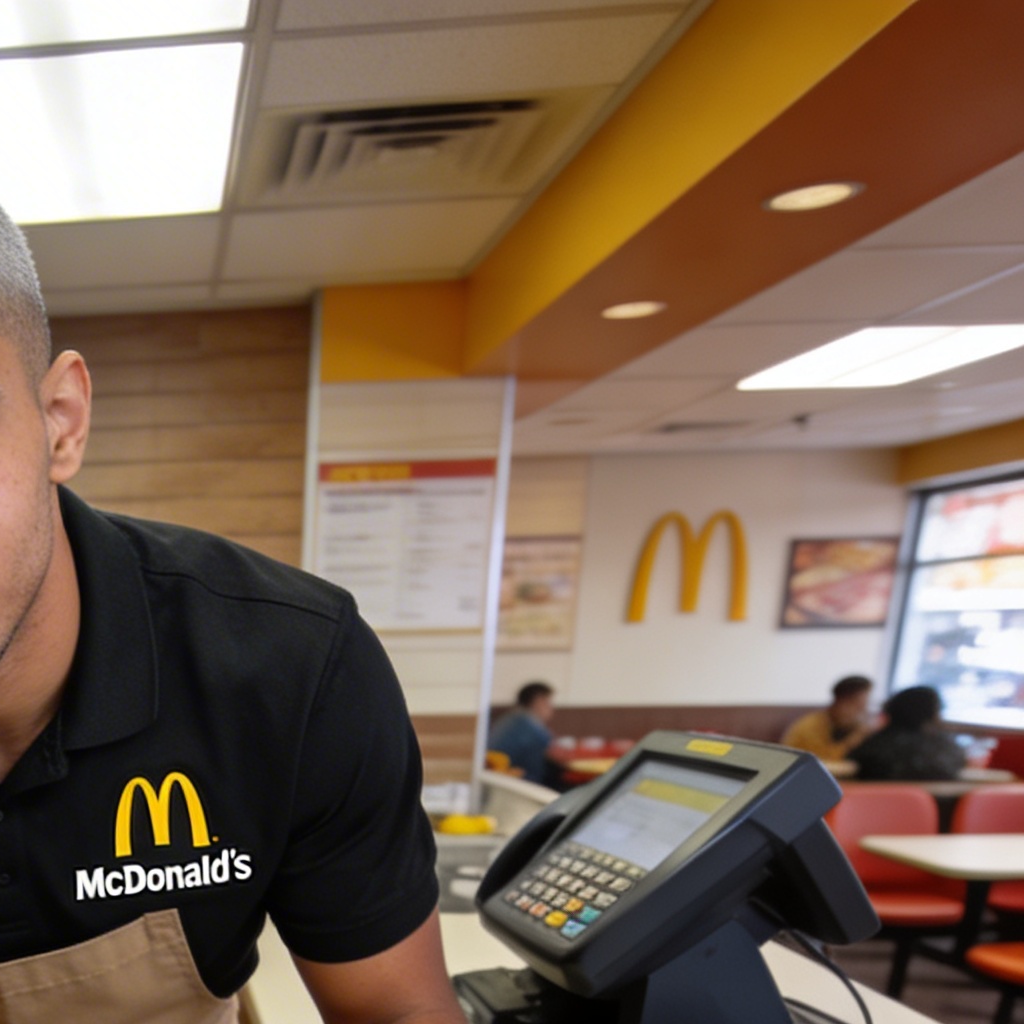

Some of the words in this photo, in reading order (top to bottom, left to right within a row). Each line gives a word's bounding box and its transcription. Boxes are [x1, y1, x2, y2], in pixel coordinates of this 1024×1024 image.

[626, 509, 748, 623] M
[115, 771, 211, 858] M
[76, 848, 252, 900] McDonald's
